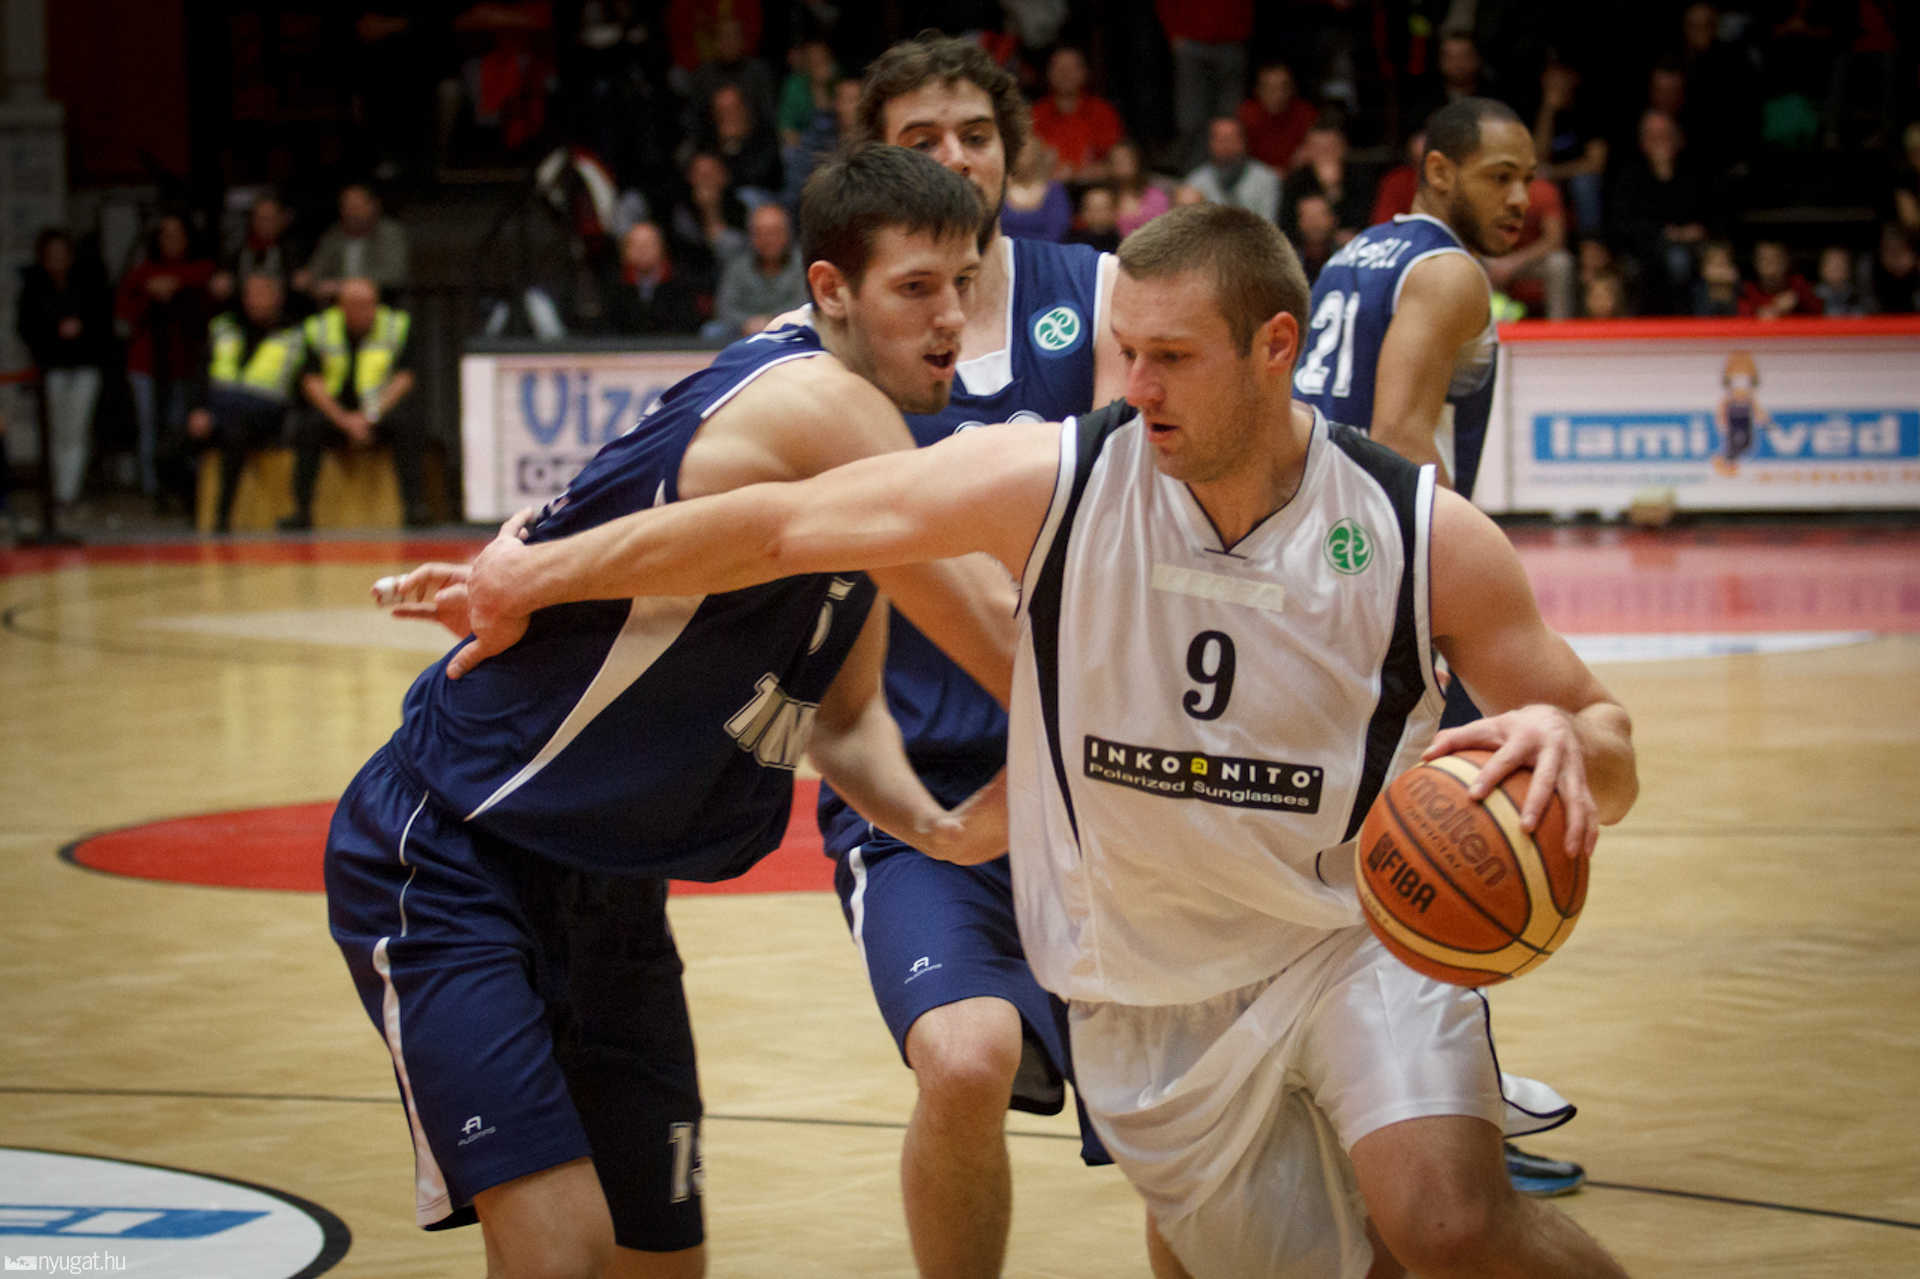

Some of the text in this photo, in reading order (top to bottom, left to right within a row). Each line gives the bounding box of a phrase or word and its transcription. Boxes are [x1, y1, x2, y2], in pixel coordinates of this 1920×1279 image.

[1294, 290, 1361, 398] 21
[519, 368, 664, 446] Viz
[1183, 629, 1236, 722] 9
[1089, 762, 1311, 807] Polarized Sunglasses
[1403, 774, 1507, 887] molten
[1380, 847, 1438, 914] FIBA
